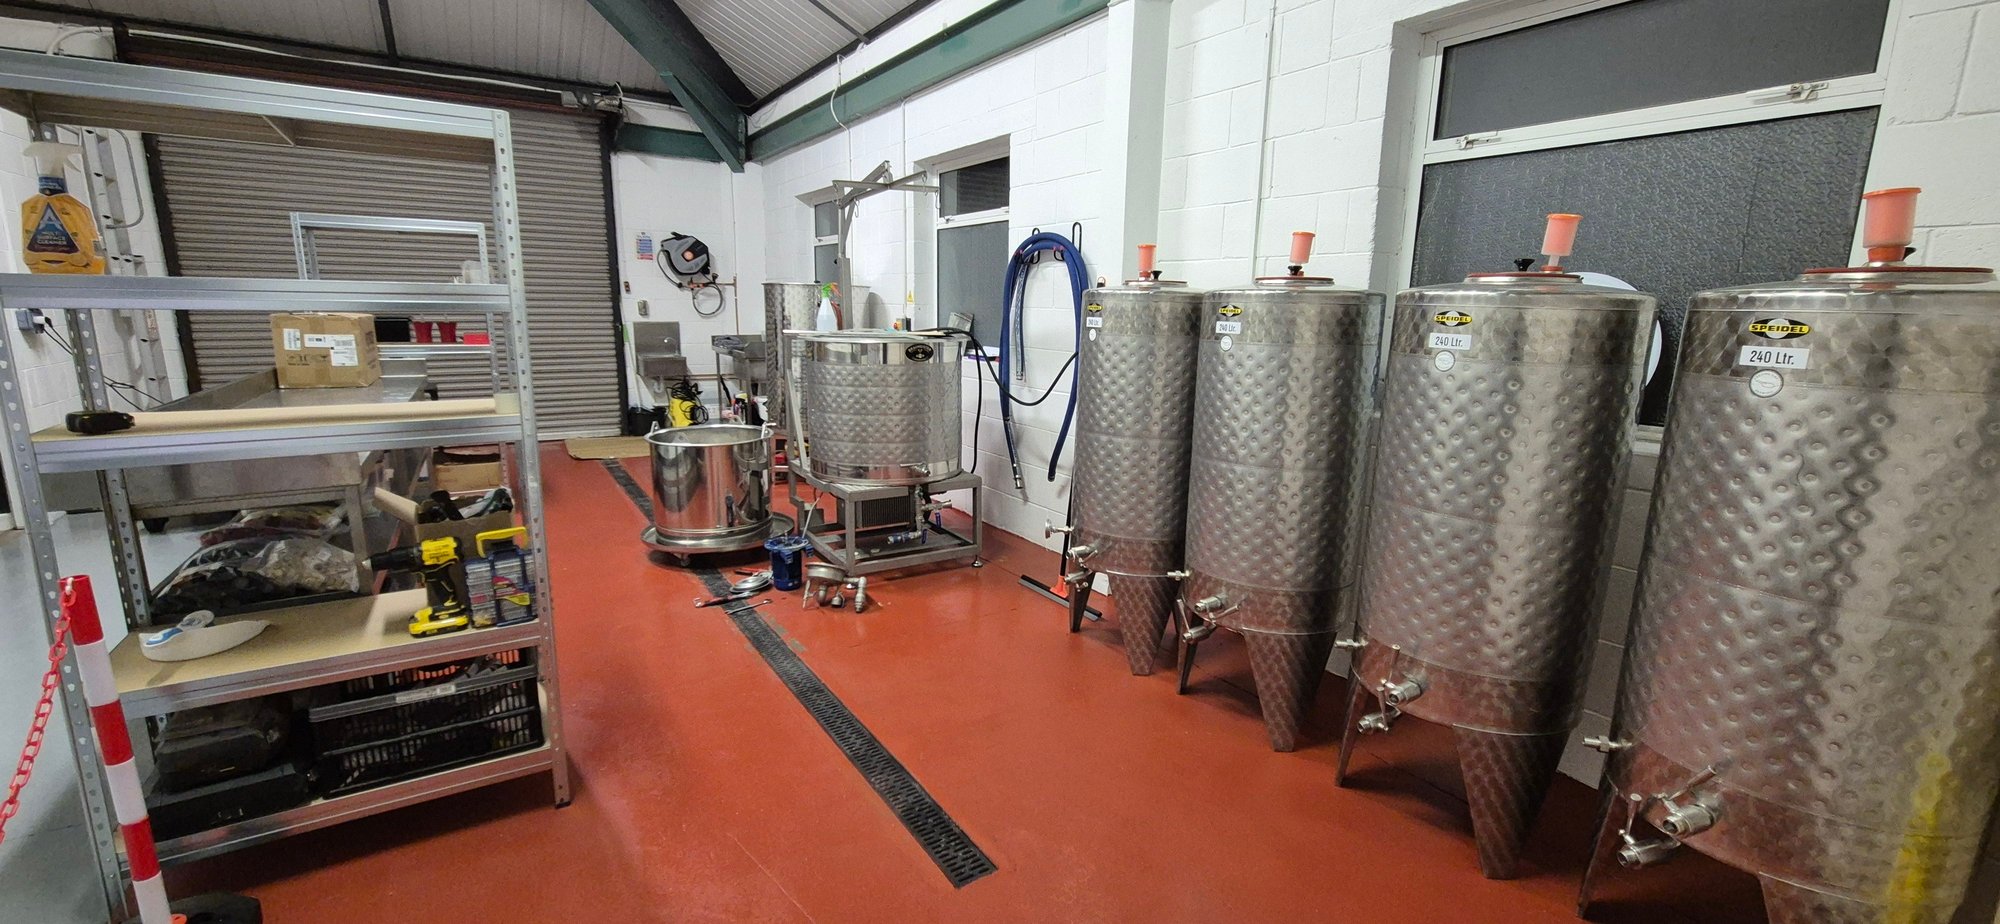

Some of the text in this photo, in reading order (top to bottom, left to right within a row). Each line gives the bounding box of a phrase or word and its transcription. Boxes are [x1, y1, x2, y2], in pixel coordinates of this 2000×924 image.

[1751, 324, 1807, 333] SPEIDEL
[1435, 336, 1463, 348] 240 Ltr.
[1749, 350, 1795, 365] 240 Ltr.
